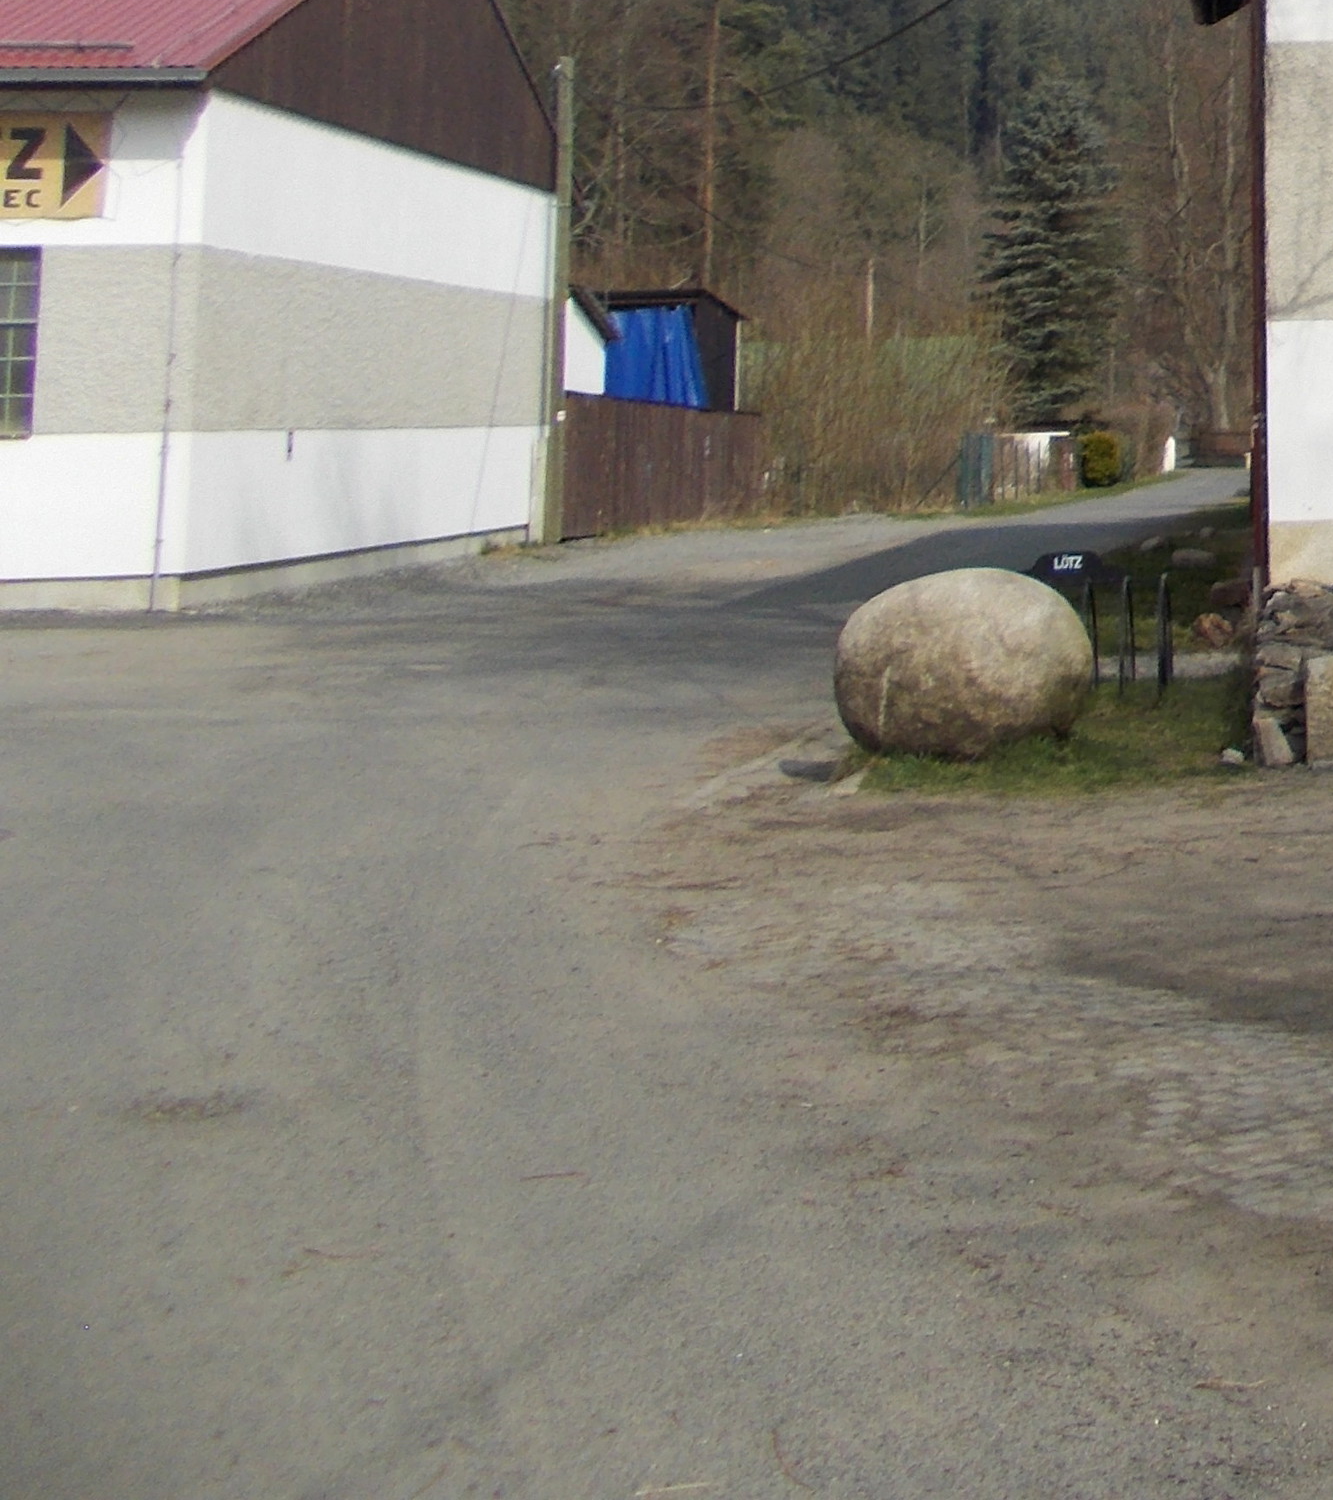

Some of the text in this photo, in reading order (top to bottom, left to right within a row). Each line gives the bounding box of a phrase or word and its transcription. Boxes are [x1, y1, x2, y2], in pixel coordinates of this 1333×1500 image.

[1, 127, 47, 180] Z
[3, 189, 42, 208] EC
[1053, 554, 1083, 570] LÖTZ
